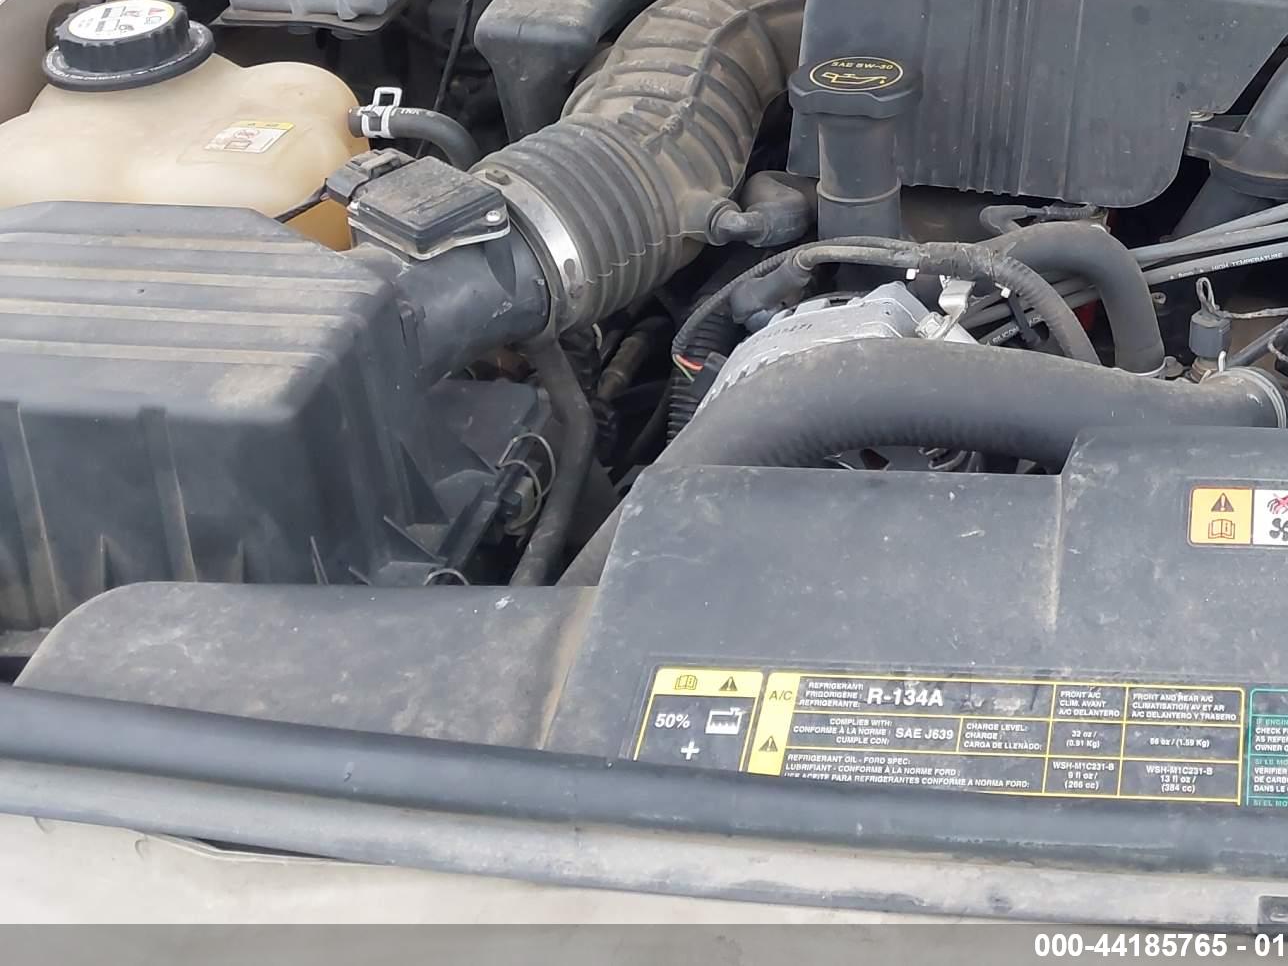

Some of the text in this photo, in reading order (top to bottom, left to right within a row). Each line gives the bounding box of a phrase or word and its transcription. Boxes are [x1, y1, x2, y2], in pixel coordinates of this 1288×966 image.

[769, 689, 793, 702] A/C
[866, 687, 945, 707] R-134A
[1060, 691, 1101, 699] FRONT A/C
[1132, 692, 1214, 703] FRONT AND REAR A/C
[1059, 699, 1107, 708] CLIM. AVANT
[1131, 702, 1225, 712] CLIMATISATION AV ET AR
[1058, 708, 1120, 717] A/C DELANTERO
[1131, 710, 1145, 718] A/C
[1146, 711, 1192, 719] DELANTERO
[655, 713, 691, 729] 50%
[829, 717, 869, 725] COMPLIES
[793, 725, 837, 734] CONFORME
[846, 727, 857, 735] LA
[858, 727, 887, 736] NORME
[966, 722, 999, 731] CHARGE
[1255, 727, 1281, 735] CHECK
[895, 727, 954, 741] SAE J639
[965, 732, 998, 740] CHARGE
[836, 736, 869, 744] CUMPLE
[1255, 735, 1266, 743] AS
[963, 740, 991, 749] CARGA
[1254, 744, 1283, 752] OWNER
[787, 753, 842, 763] REFRIGERANT
[844, 755, 857, 763] OIL
[863, 756, 886, 765] FORD
[785, 763, 832, 772] LUBRIFIANT
[838, 765, 882, 774] CONFORME
[891, 766, 902, 775] LA
[903, 767, 932, 776] NORME
[934, 768, 956, 776] FORD
[1052, 761, 1115, 771] WSH-M1C231-B
[1145, 765, 1213, 776] WSH-M1C231-B
[831, 774, 852, 782] PARA
[854, 774, 920, 785] REFRIGERANTES
[921, 777, 966, 786] CONFORME
[974, 778, 1004, 787] NORMA
[1160, 775, 1171, 783] 13
[1085, 781, 1100, 790] cc)
[1161, 784, 1196, 794] (384 cc)
[1253, 784, 1274, 793] DANS
[1276, 785, 1286, 793] LE
